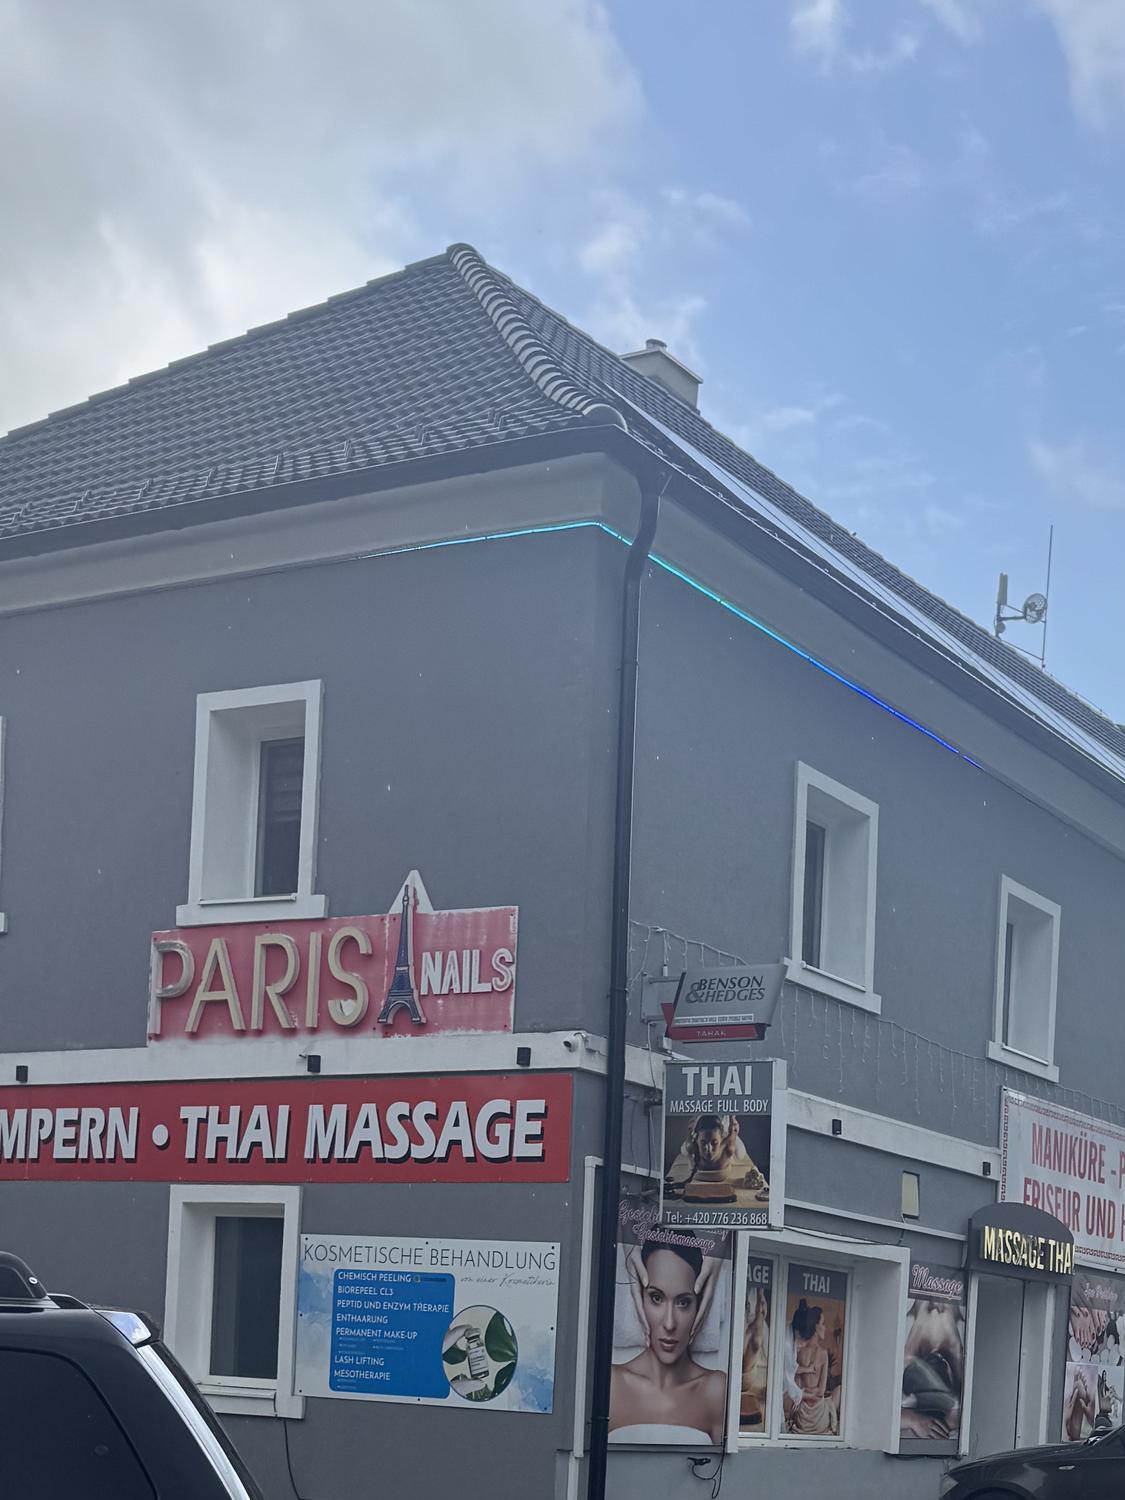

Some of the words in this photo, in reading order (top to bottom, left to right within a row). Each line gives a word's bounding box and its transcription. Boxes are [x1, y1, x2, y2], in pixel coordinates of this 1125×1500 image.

[149, 926, 374, 1035] PARIS
[420, 948, 515, 995] NAILS
[700, 975, 764, 990] BENSON
[682, 1066, 752, 1096] THAI
[670, 1100, 713, 1113] MASSAGE
[717, 1100, 739, 1113] FULL
[743, 1099, 768, 1112] BODY
[0, 1107, 139, 1159] MPERN
[180, 1105, 289, 1159] THAI
[304, 1099, 546, 1159] MASSAGE
[1032, 1122, 1105, 1184] MANIKÜRE
[1024, 1177, 1080, 1232] FRISEUR
[1086, 1195, 1116, 1240] UND
[666, 1211, 683, 1223] Tel:
[684, 1212, 709, 1224] +420
[712, 1212, 729, 1224] 776
[731, 1213, 748, 1224] 236
[750, 1213, 767, 1224] 868
[984, 1226, 1046, 1270] MASSAGE
[304, 1244, 423, 1265] KOSMETISCHE
[430, 1248, 556, 1271] BEHANDLUNG
[338, 1271, 377, 1281] CHEMISCH
[380, 1273, 412, 1283] PEELING
[803, 1272, 831, 1294] THAI
[911, 1264, 962, 1296] Massage
[337, 1285, 378, 1296] BIOREPEEL
[336, 1299, 362, 1309] PEPTID
[364, 1300, 381, 1310] UND
[383, 1302, 411, 1312] ENZYM
[413, 1303, 449, 1313] THERAPIE
[336, 1313, 388, 1324] ENTHAARUNG
[336, 1327, 381, 1338] PERMANENT
[384, 1331, 418, 1340] MAKE-UP
[334, 1355, 354, 1364] LASH
[356, 1357, 384, 1366] LIFTING
[334, 1369, 391, 1381] MESOTHERAPIE
